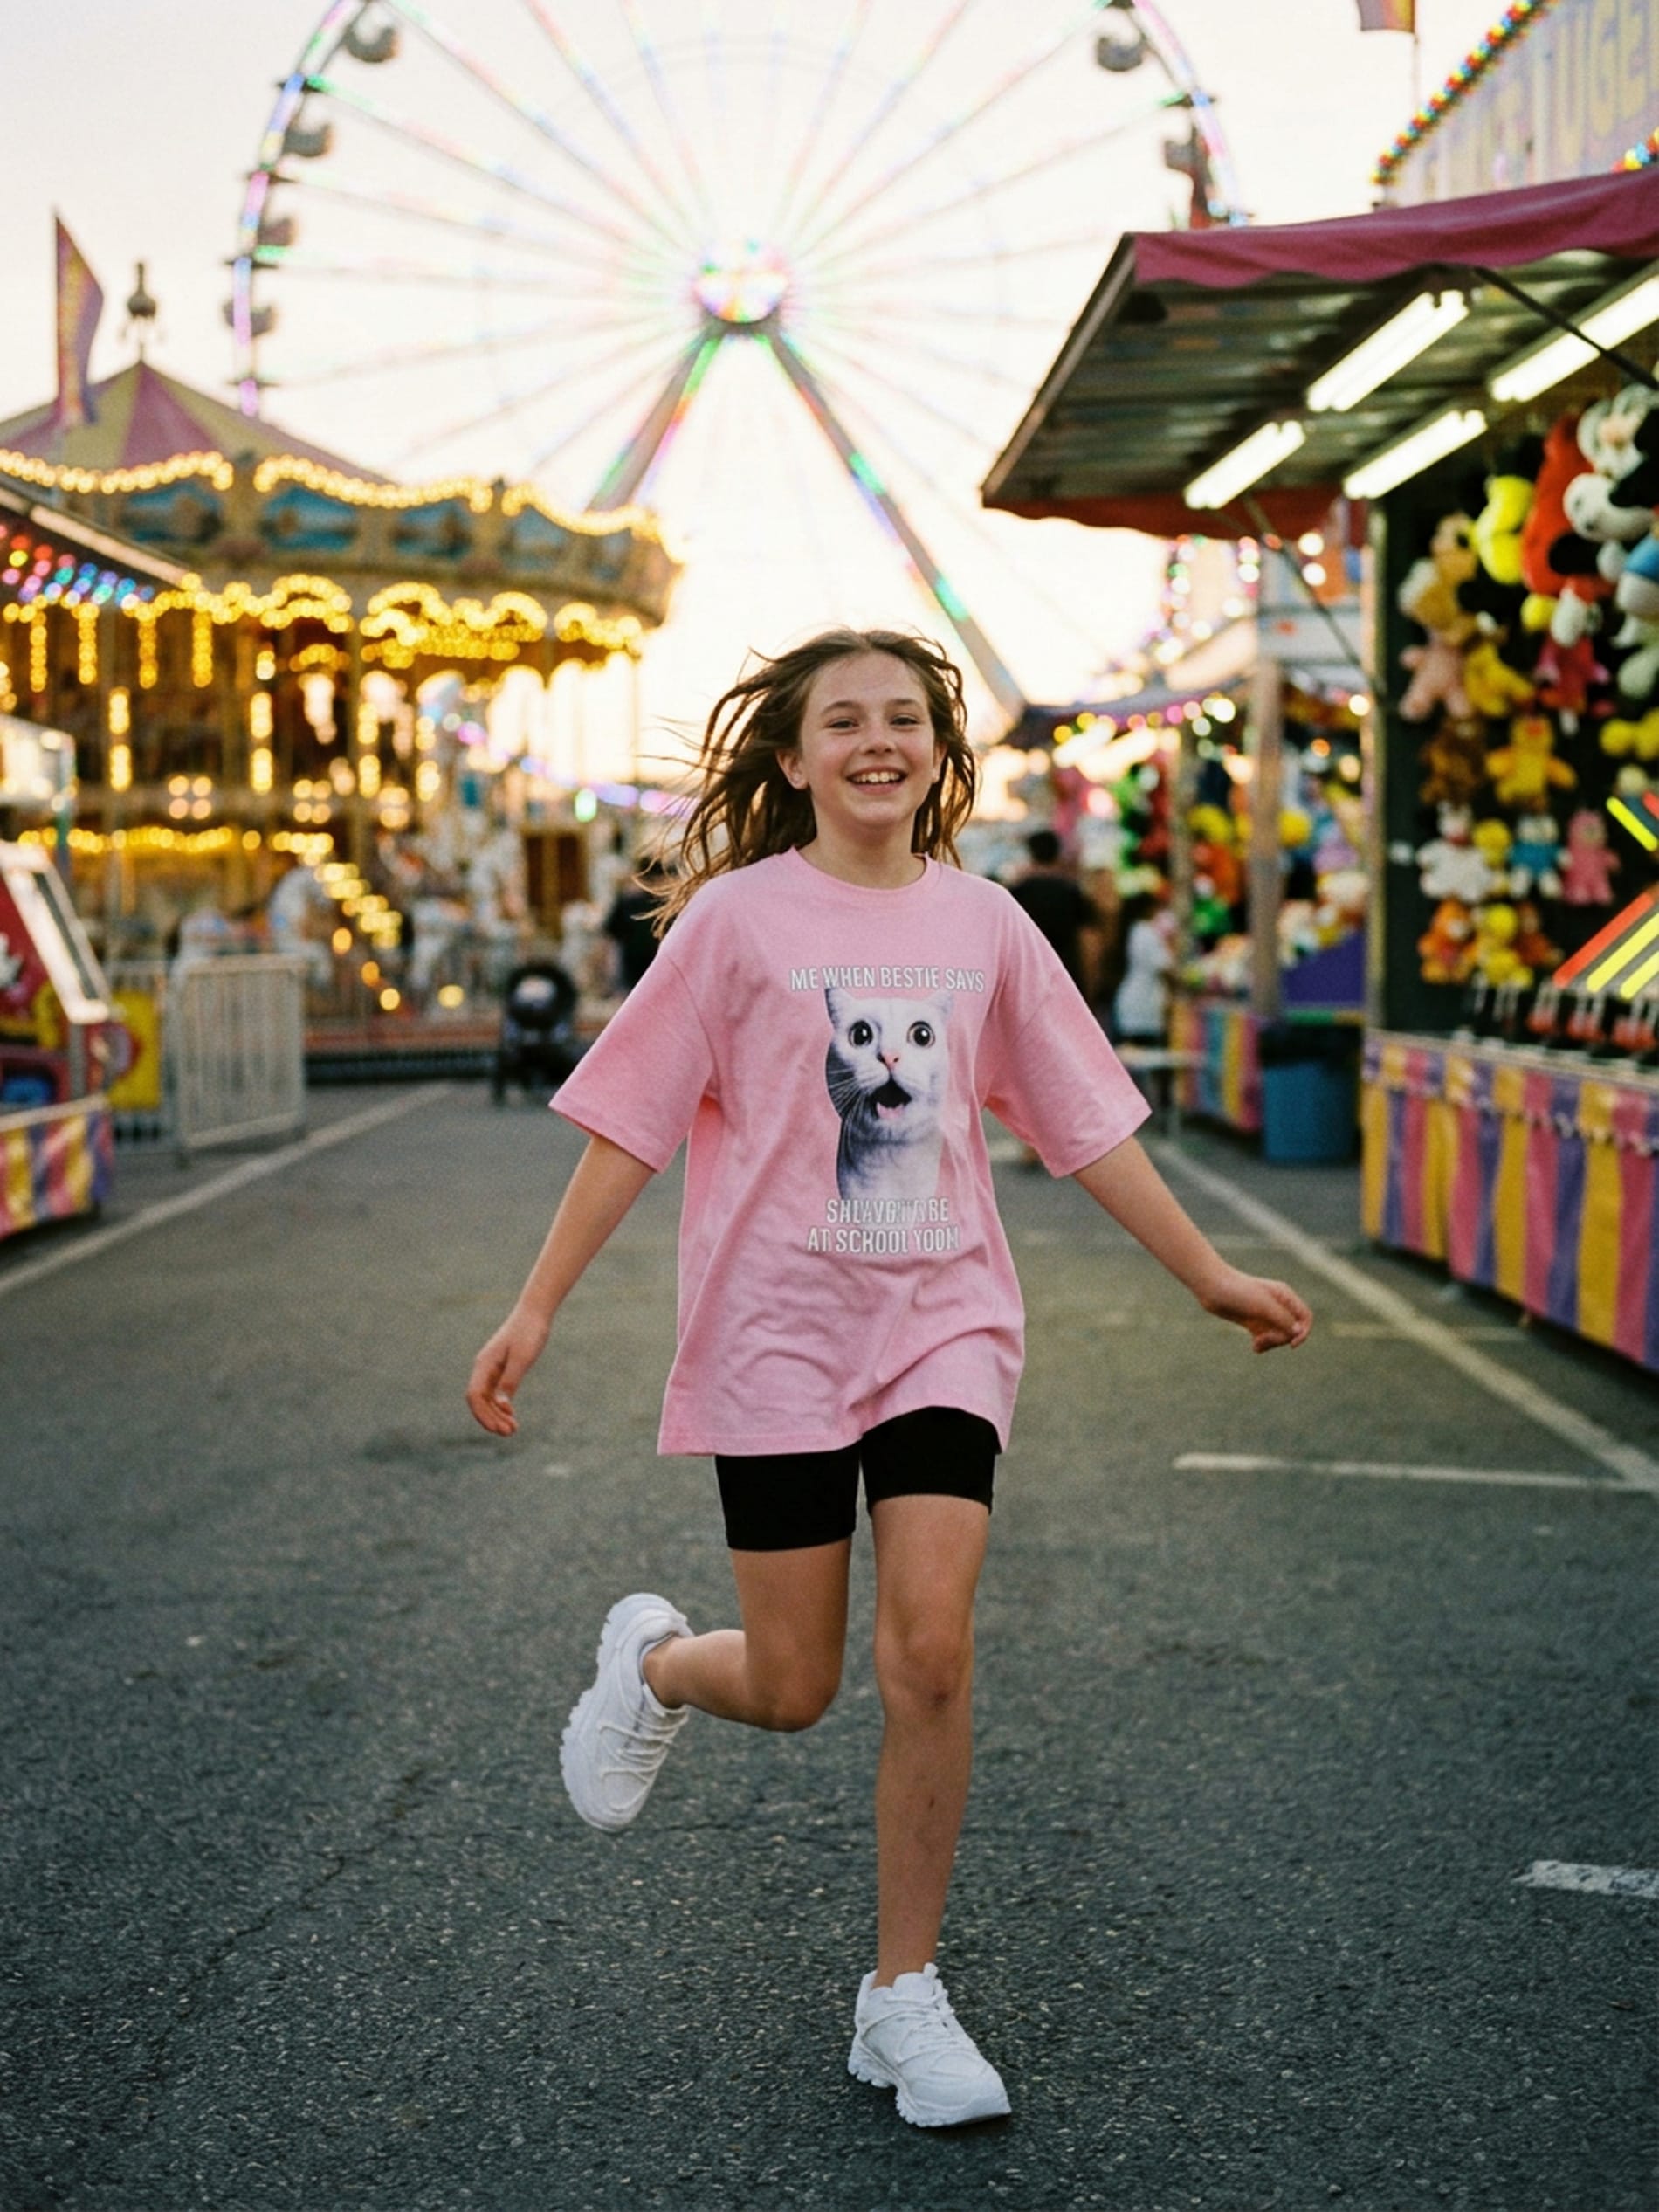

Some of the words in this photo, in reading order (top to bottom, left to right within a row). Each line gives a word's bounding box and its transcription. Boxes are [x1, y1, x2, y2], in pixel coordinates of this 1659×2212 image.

[791, 968, 817, 989] ME
[823, 968, 874, 988] WHEN
[880, 967, 939, 988] BESTIE
[945, 968, 984, 992] SAYS
